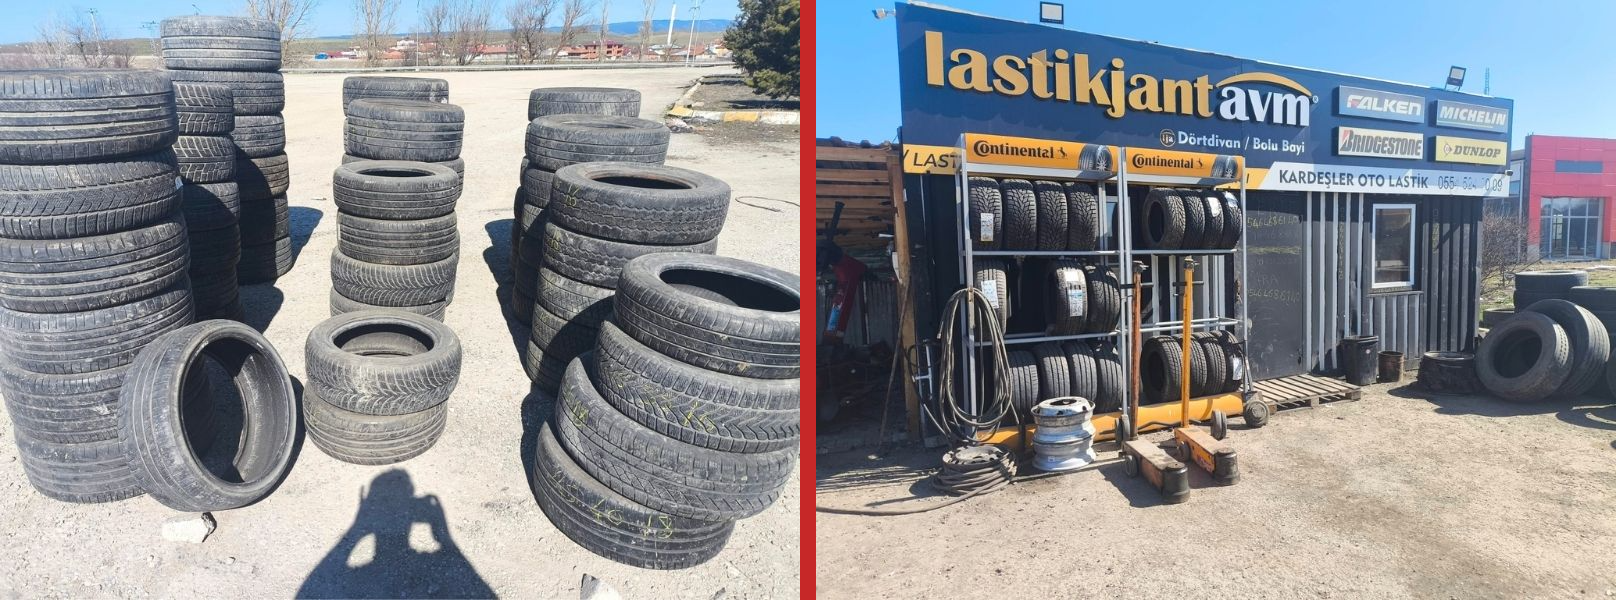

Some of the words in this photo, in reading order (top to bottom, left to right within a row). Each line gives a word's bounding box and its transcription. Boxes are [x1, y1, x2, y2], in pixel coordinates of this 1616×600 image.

[1346, 95, 1421, 116] FALKEN
[1439, 106, 1506, 126] MICHELIN
[973, 140, 1054, 159] Continental
[1178, 131, 1241, 149] Dörtdivan
[1253, 137, 1278, 151] Bolu
[1282, 140, 1305, 155] Bayi
[1340, 130, 1422, 157] BRIDGESTONE
[1453, 145, 1501, 158] DUNLOP
[1132, 153, 1194, 169] Continental
[1279, 169, 1354, 189] KARDEŞLER
[1358, 173, 1384, 187] OTO
[1389, 172, 1429, 189] LASTİK
